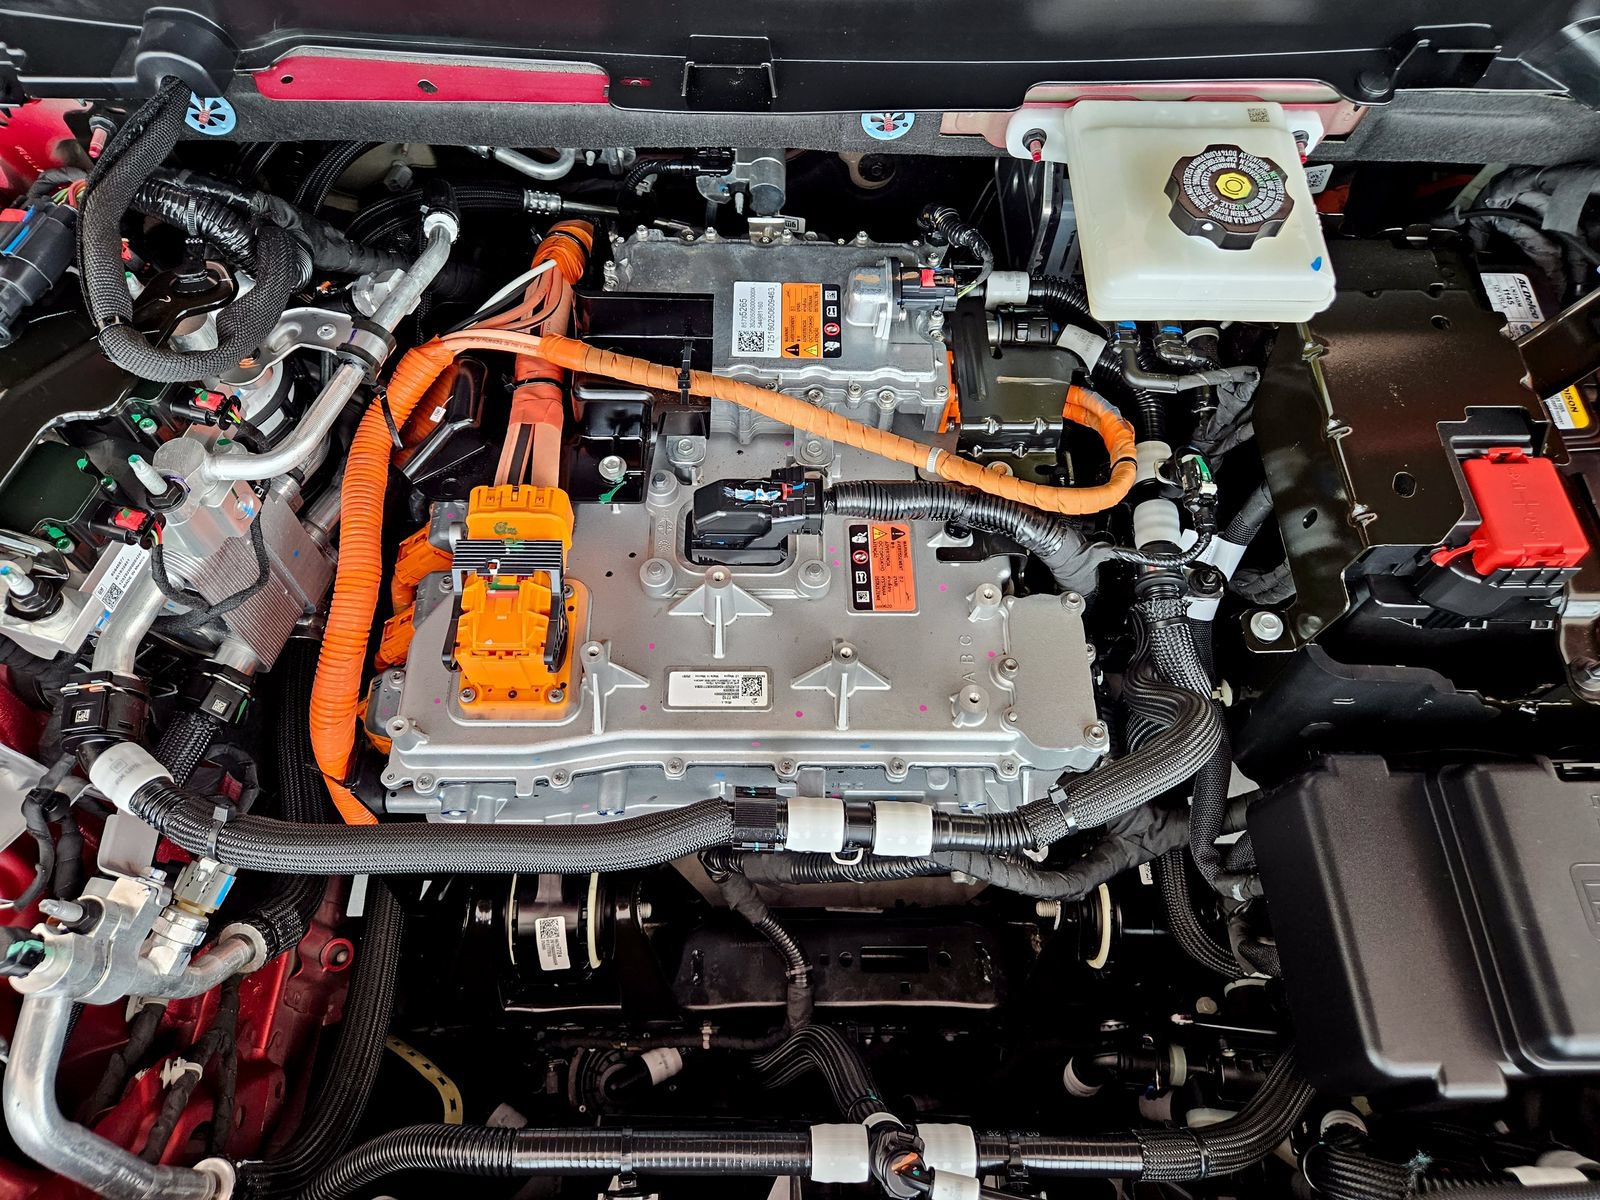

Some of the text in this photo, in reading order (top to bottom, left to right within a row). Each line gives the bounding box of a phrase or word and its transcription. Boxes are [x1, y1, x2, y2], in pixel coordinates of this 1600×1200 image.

[1518, 278, 1538, 319] ACDelco
[959, 634, 976, 683] A B C
